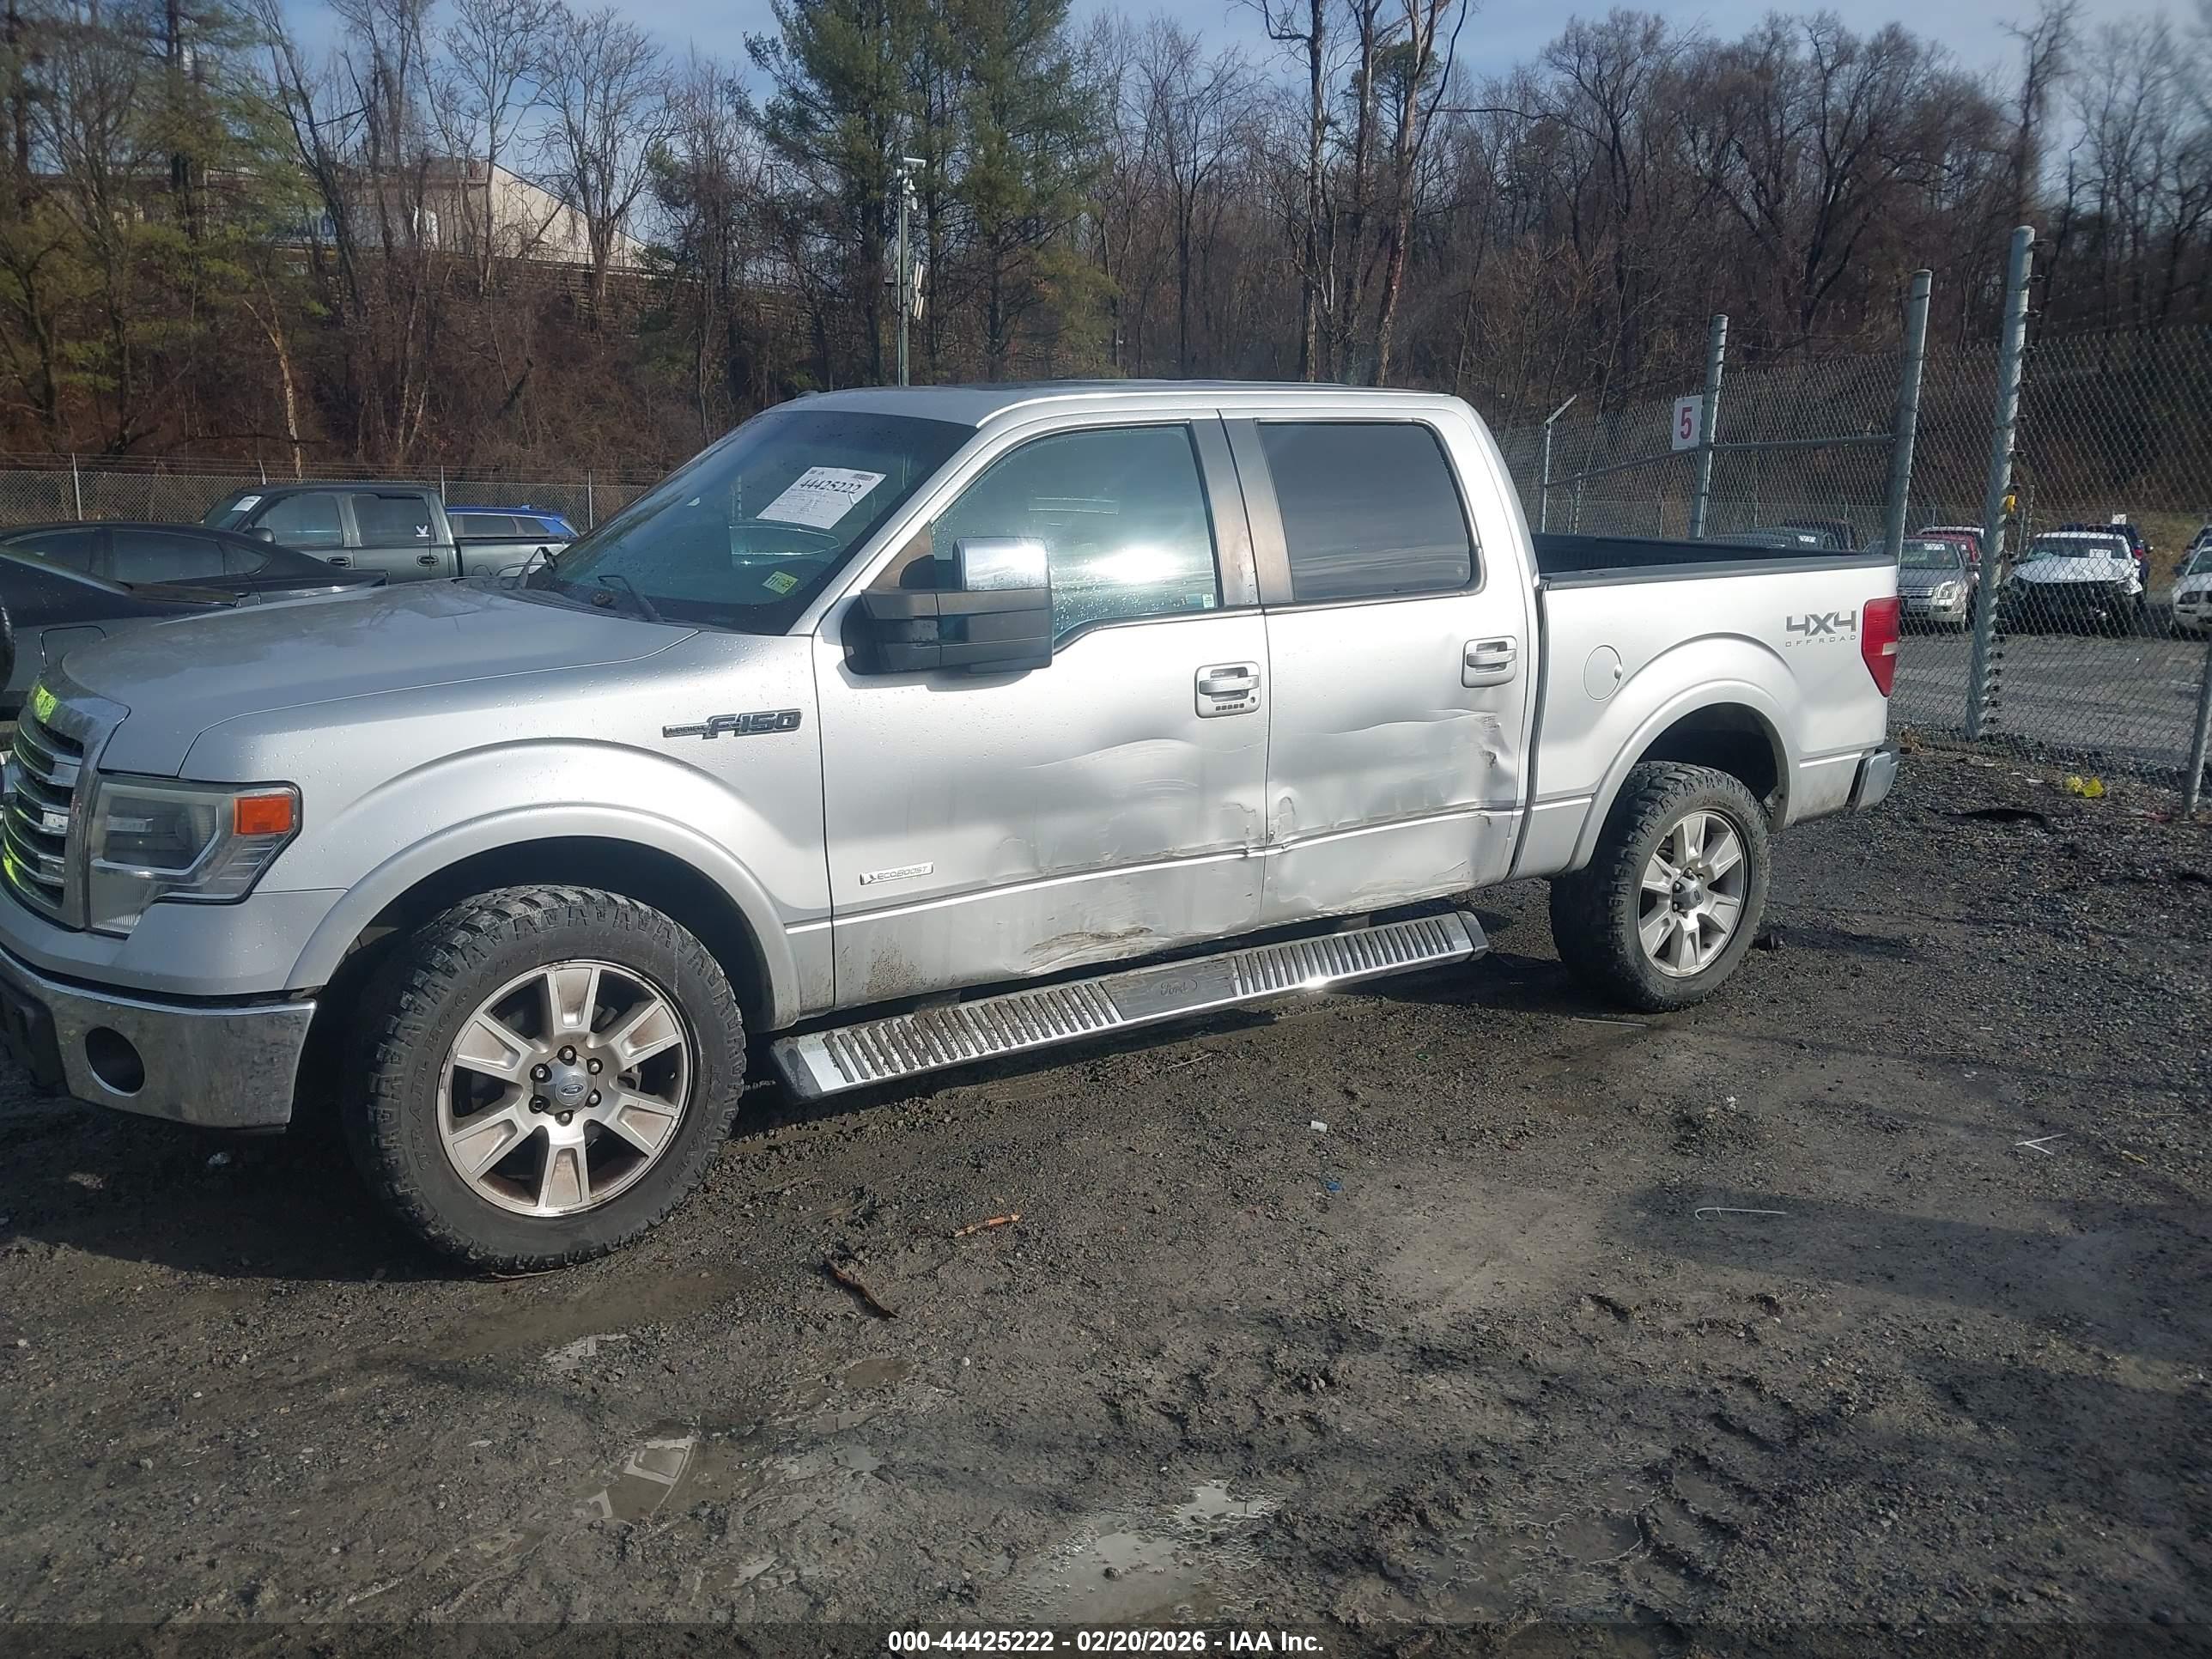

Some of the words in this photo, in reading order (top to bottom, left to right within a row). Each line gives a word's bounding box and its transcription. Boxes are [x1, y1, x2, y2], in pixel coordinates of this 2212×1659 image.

[1680, 406, 1693, 439] 5
[799, 478, 862, 495] 44425222
[1819, 635, 1856, 644] ROAD
[1160, 981, 1188, 996] Ford
